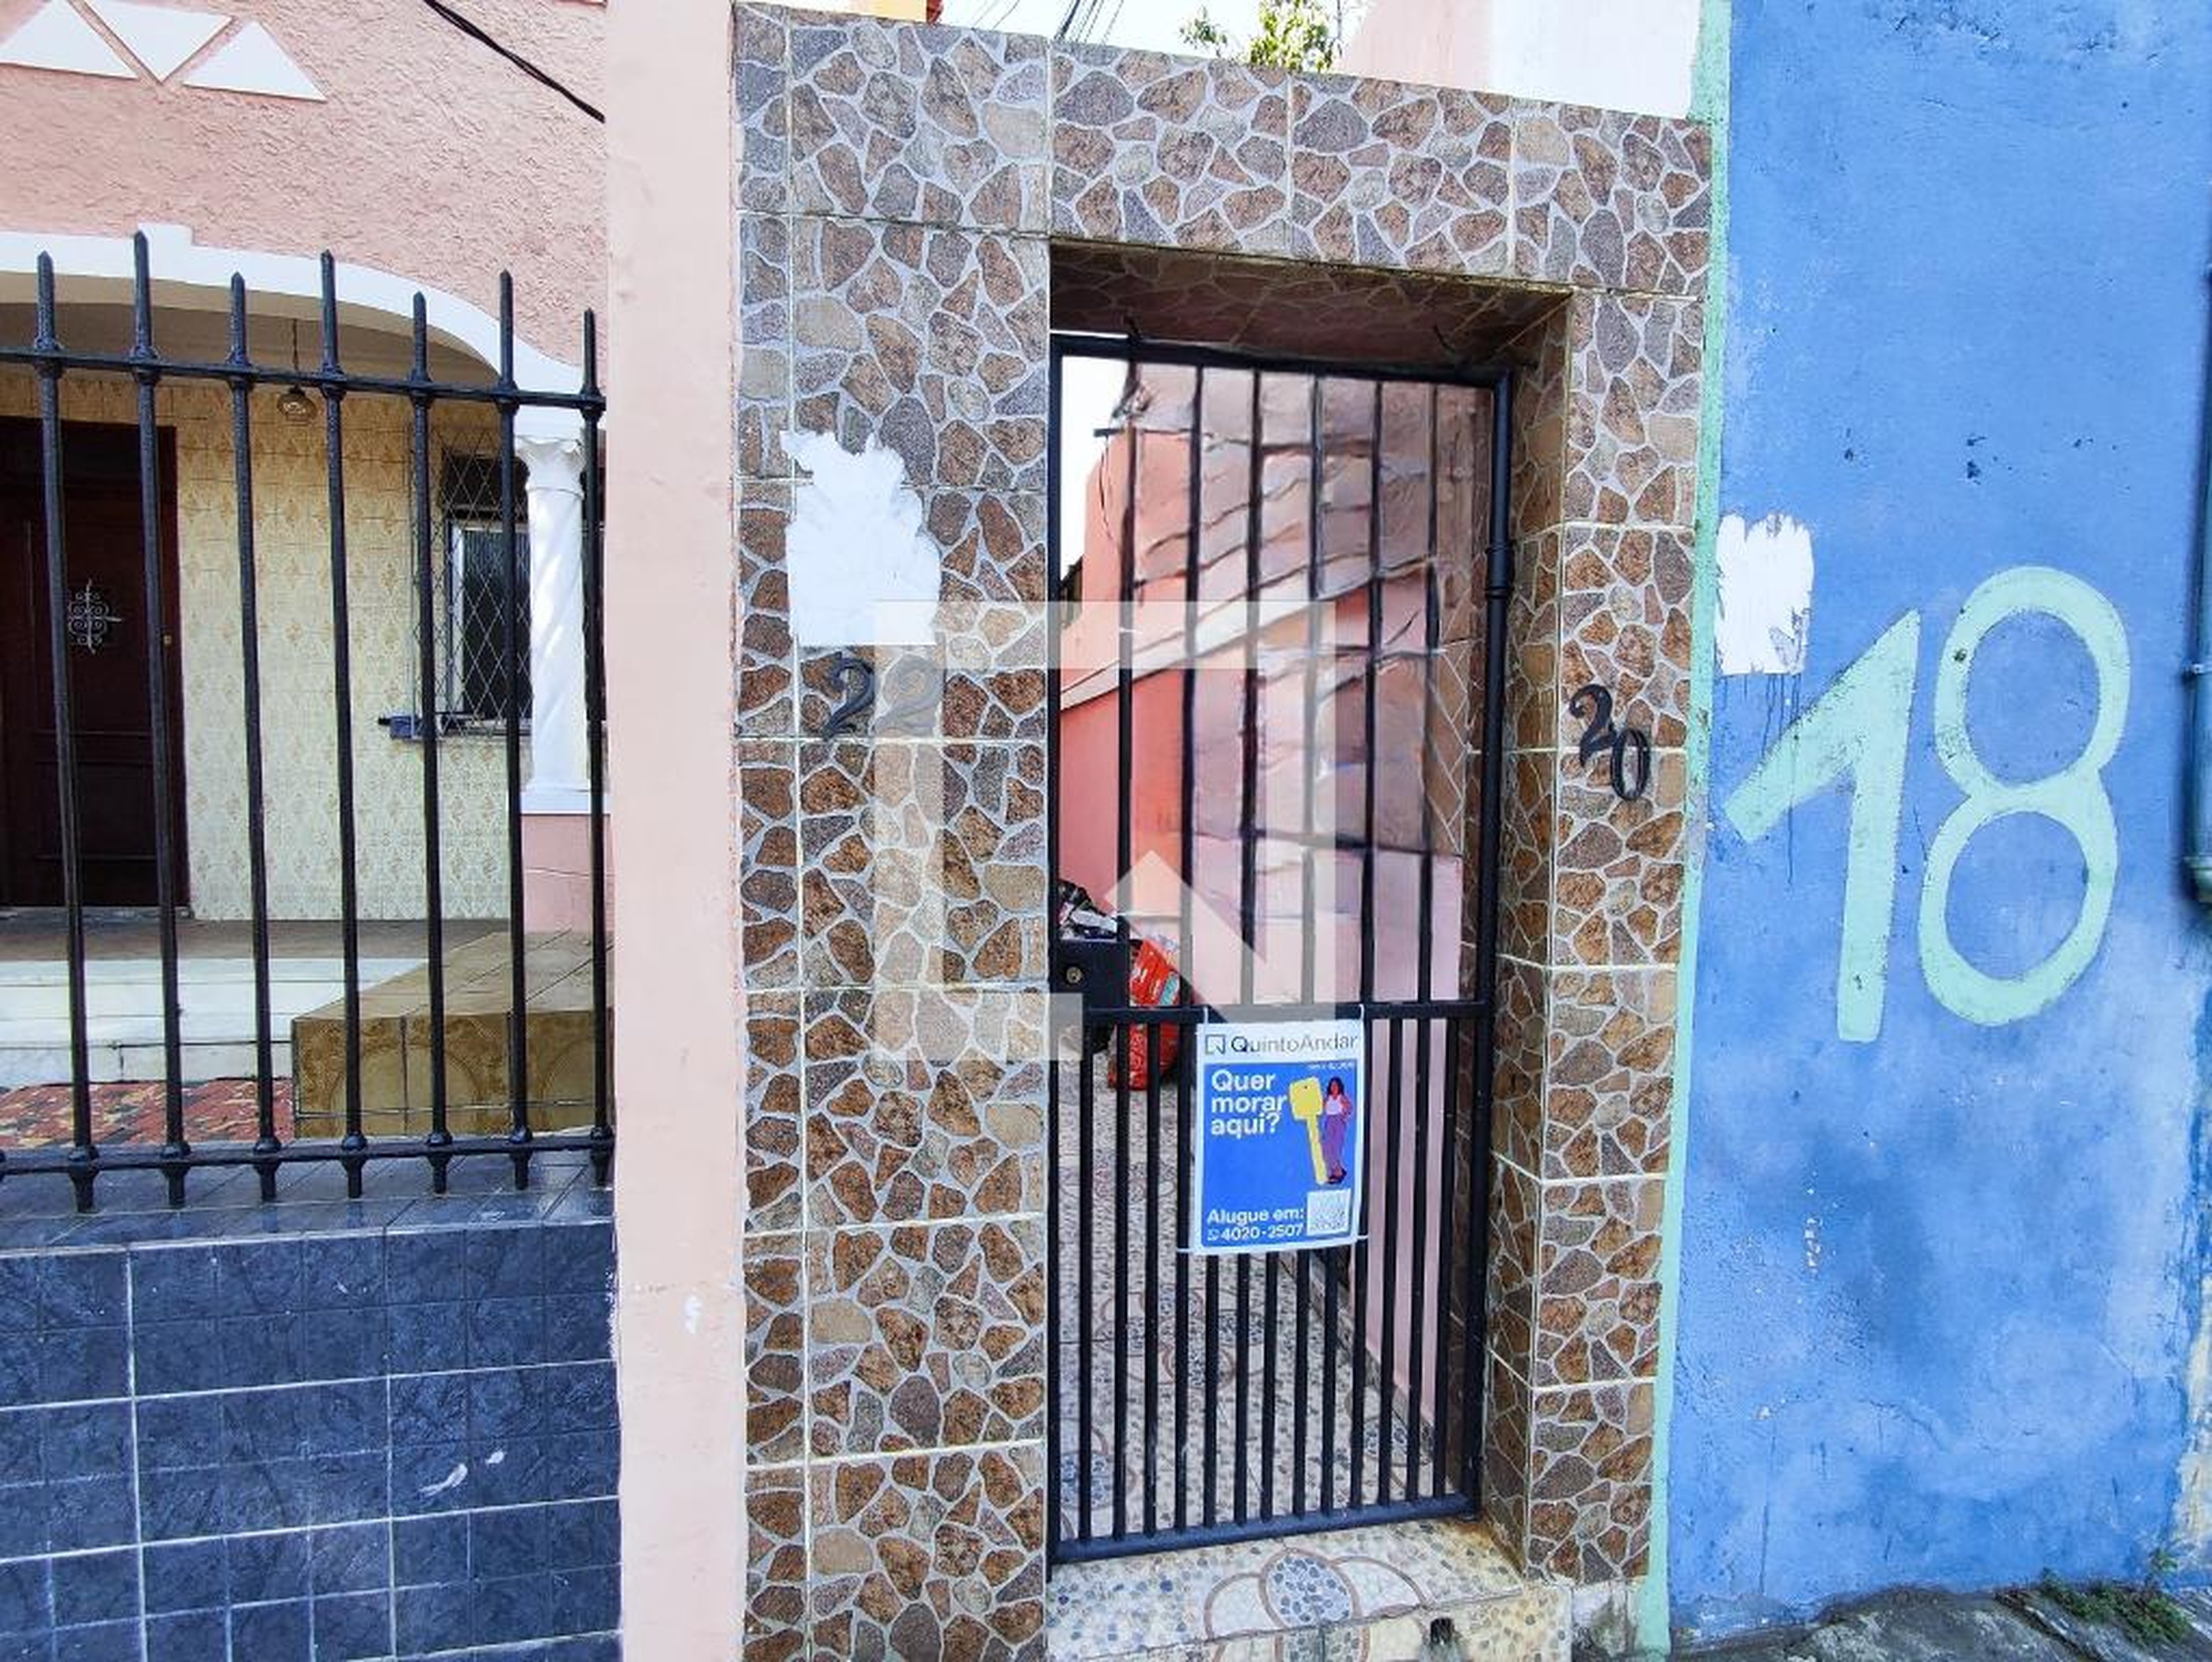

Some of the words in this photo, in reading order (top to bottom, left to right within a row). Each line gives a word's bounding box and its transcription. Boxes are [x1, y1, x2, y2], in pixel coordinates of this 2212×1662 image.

[1569, 684, 1650, 800] 20
[1727, 566, 2130, 1042] 18
[1230, 1033, 1358, 1054] QuintoAndar
[1211, 1069, 1275, 1092] Quer
[1211, 1094, 1287, 1114] morar
[1210, 1114, 1279, 1139] aqui?
[1207, 1209, 1269, 1227] Alugue
[1272, 1208, 1304, 1221] em:
